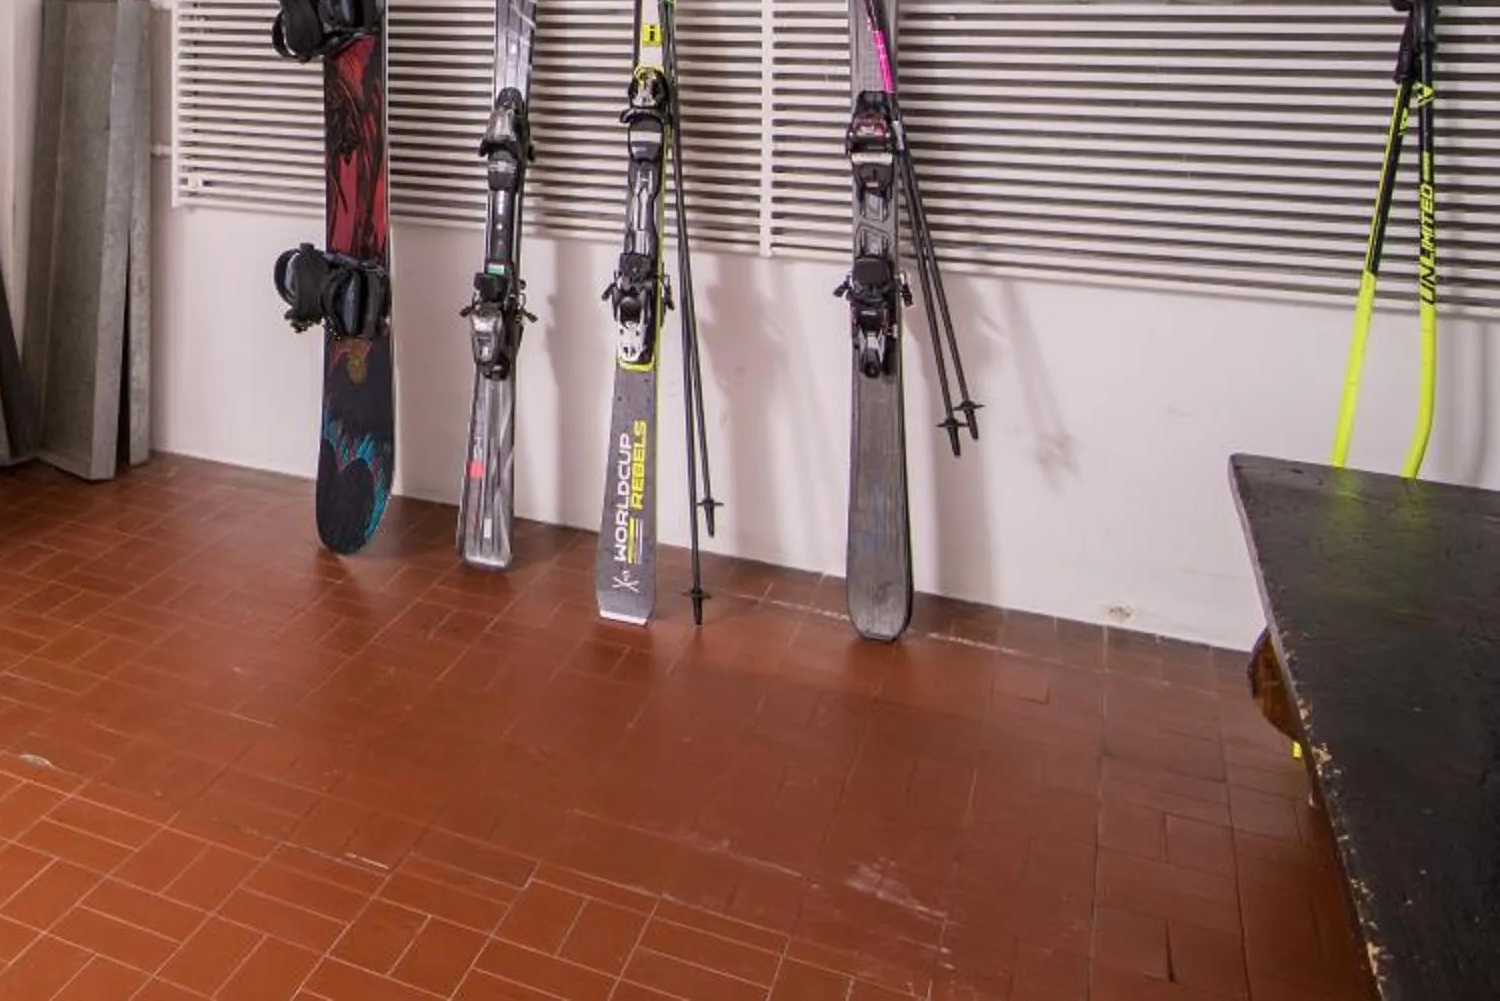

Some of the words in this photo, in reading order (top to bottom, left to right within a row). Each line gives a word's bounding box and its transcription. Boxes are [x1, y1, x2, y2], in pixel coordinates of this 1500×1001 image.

[1419, 183, 1436, 307] UNLIMITED
[614, 433, 632, 562] WORLDCUP
[631, 420, 647, 510] REBELS
